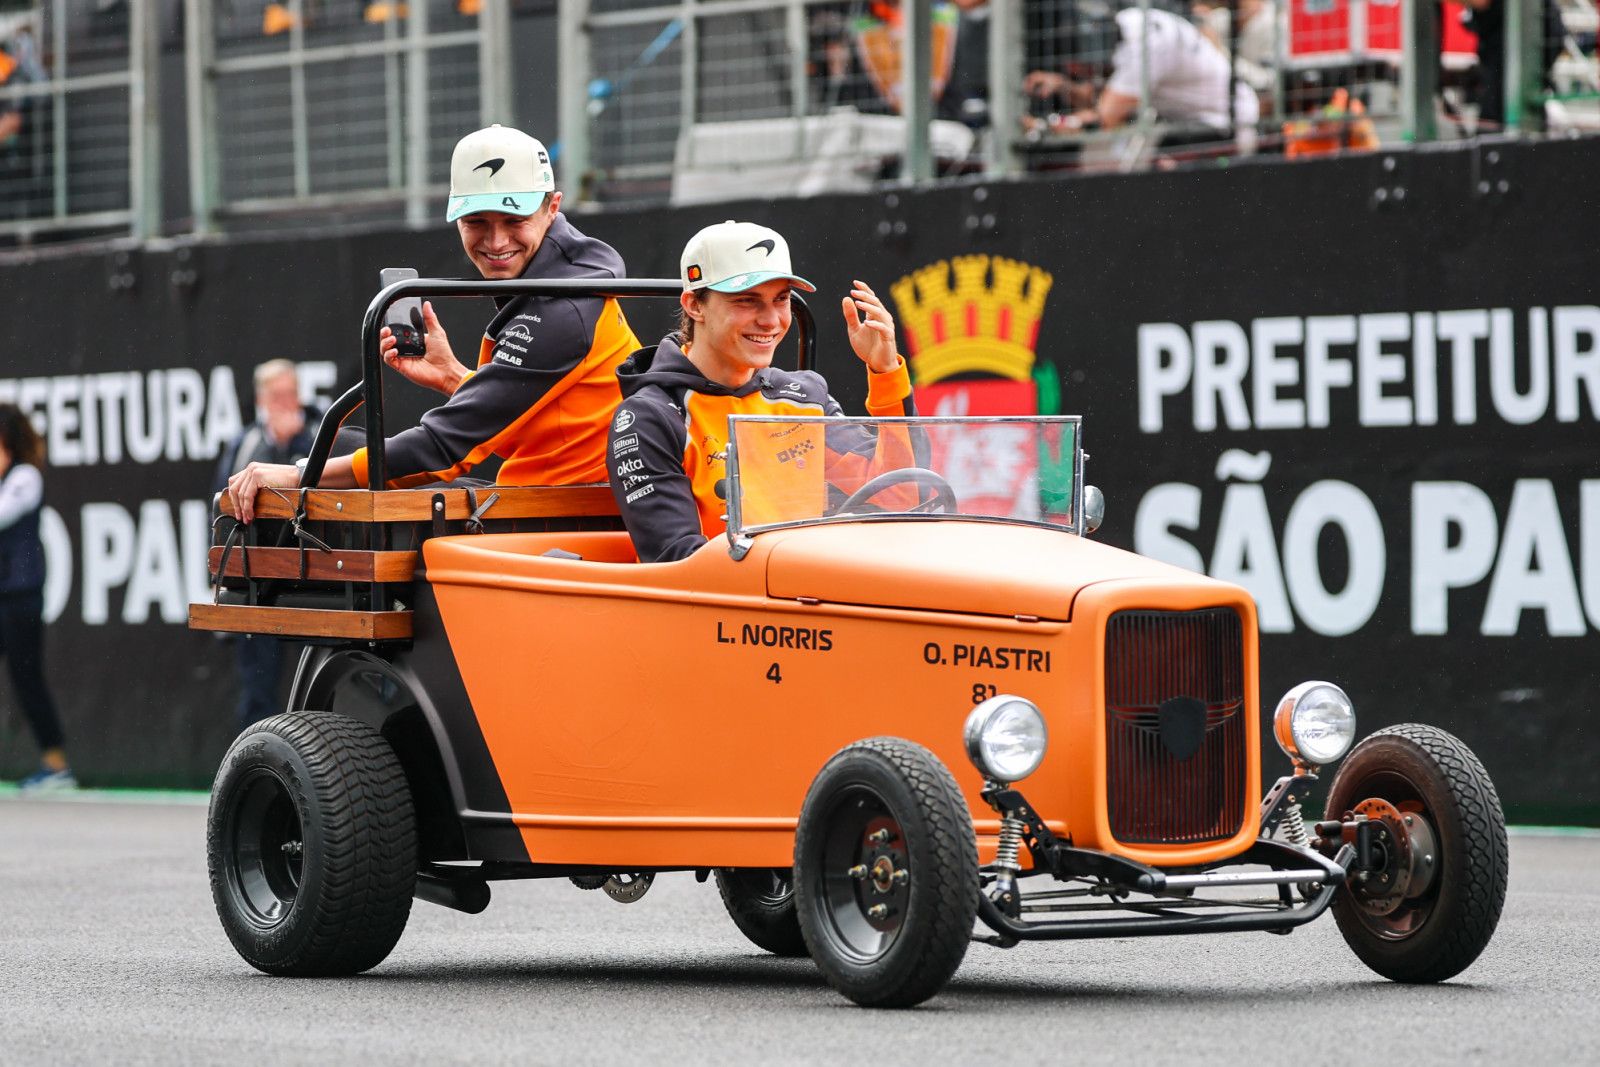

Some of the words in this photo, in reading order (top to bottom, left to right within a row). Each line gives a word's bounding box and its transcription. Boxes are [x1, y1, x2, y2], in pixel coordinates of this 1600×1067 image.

[502, 196, 521, 210] 4
[505, 330, 534, 343] workday
[1137, 305, 1600, 433] PREFEITUR
[614, 437, 636, 450] Hilton
[617, 458, 645, 476] okta
[622, 474, 650, 491] FxPro
[626, 483, 655, 504] PIRELLI
[1133, 448, 1387, 637] SÃO
[717, 621, 736, 645] L.
[742, 624, 833, 652] NORRIS
[923, 642, 947, 666] O.
[953, 644, 1051, 673] PIASTRI
[766, 662, 782, 684] 4
